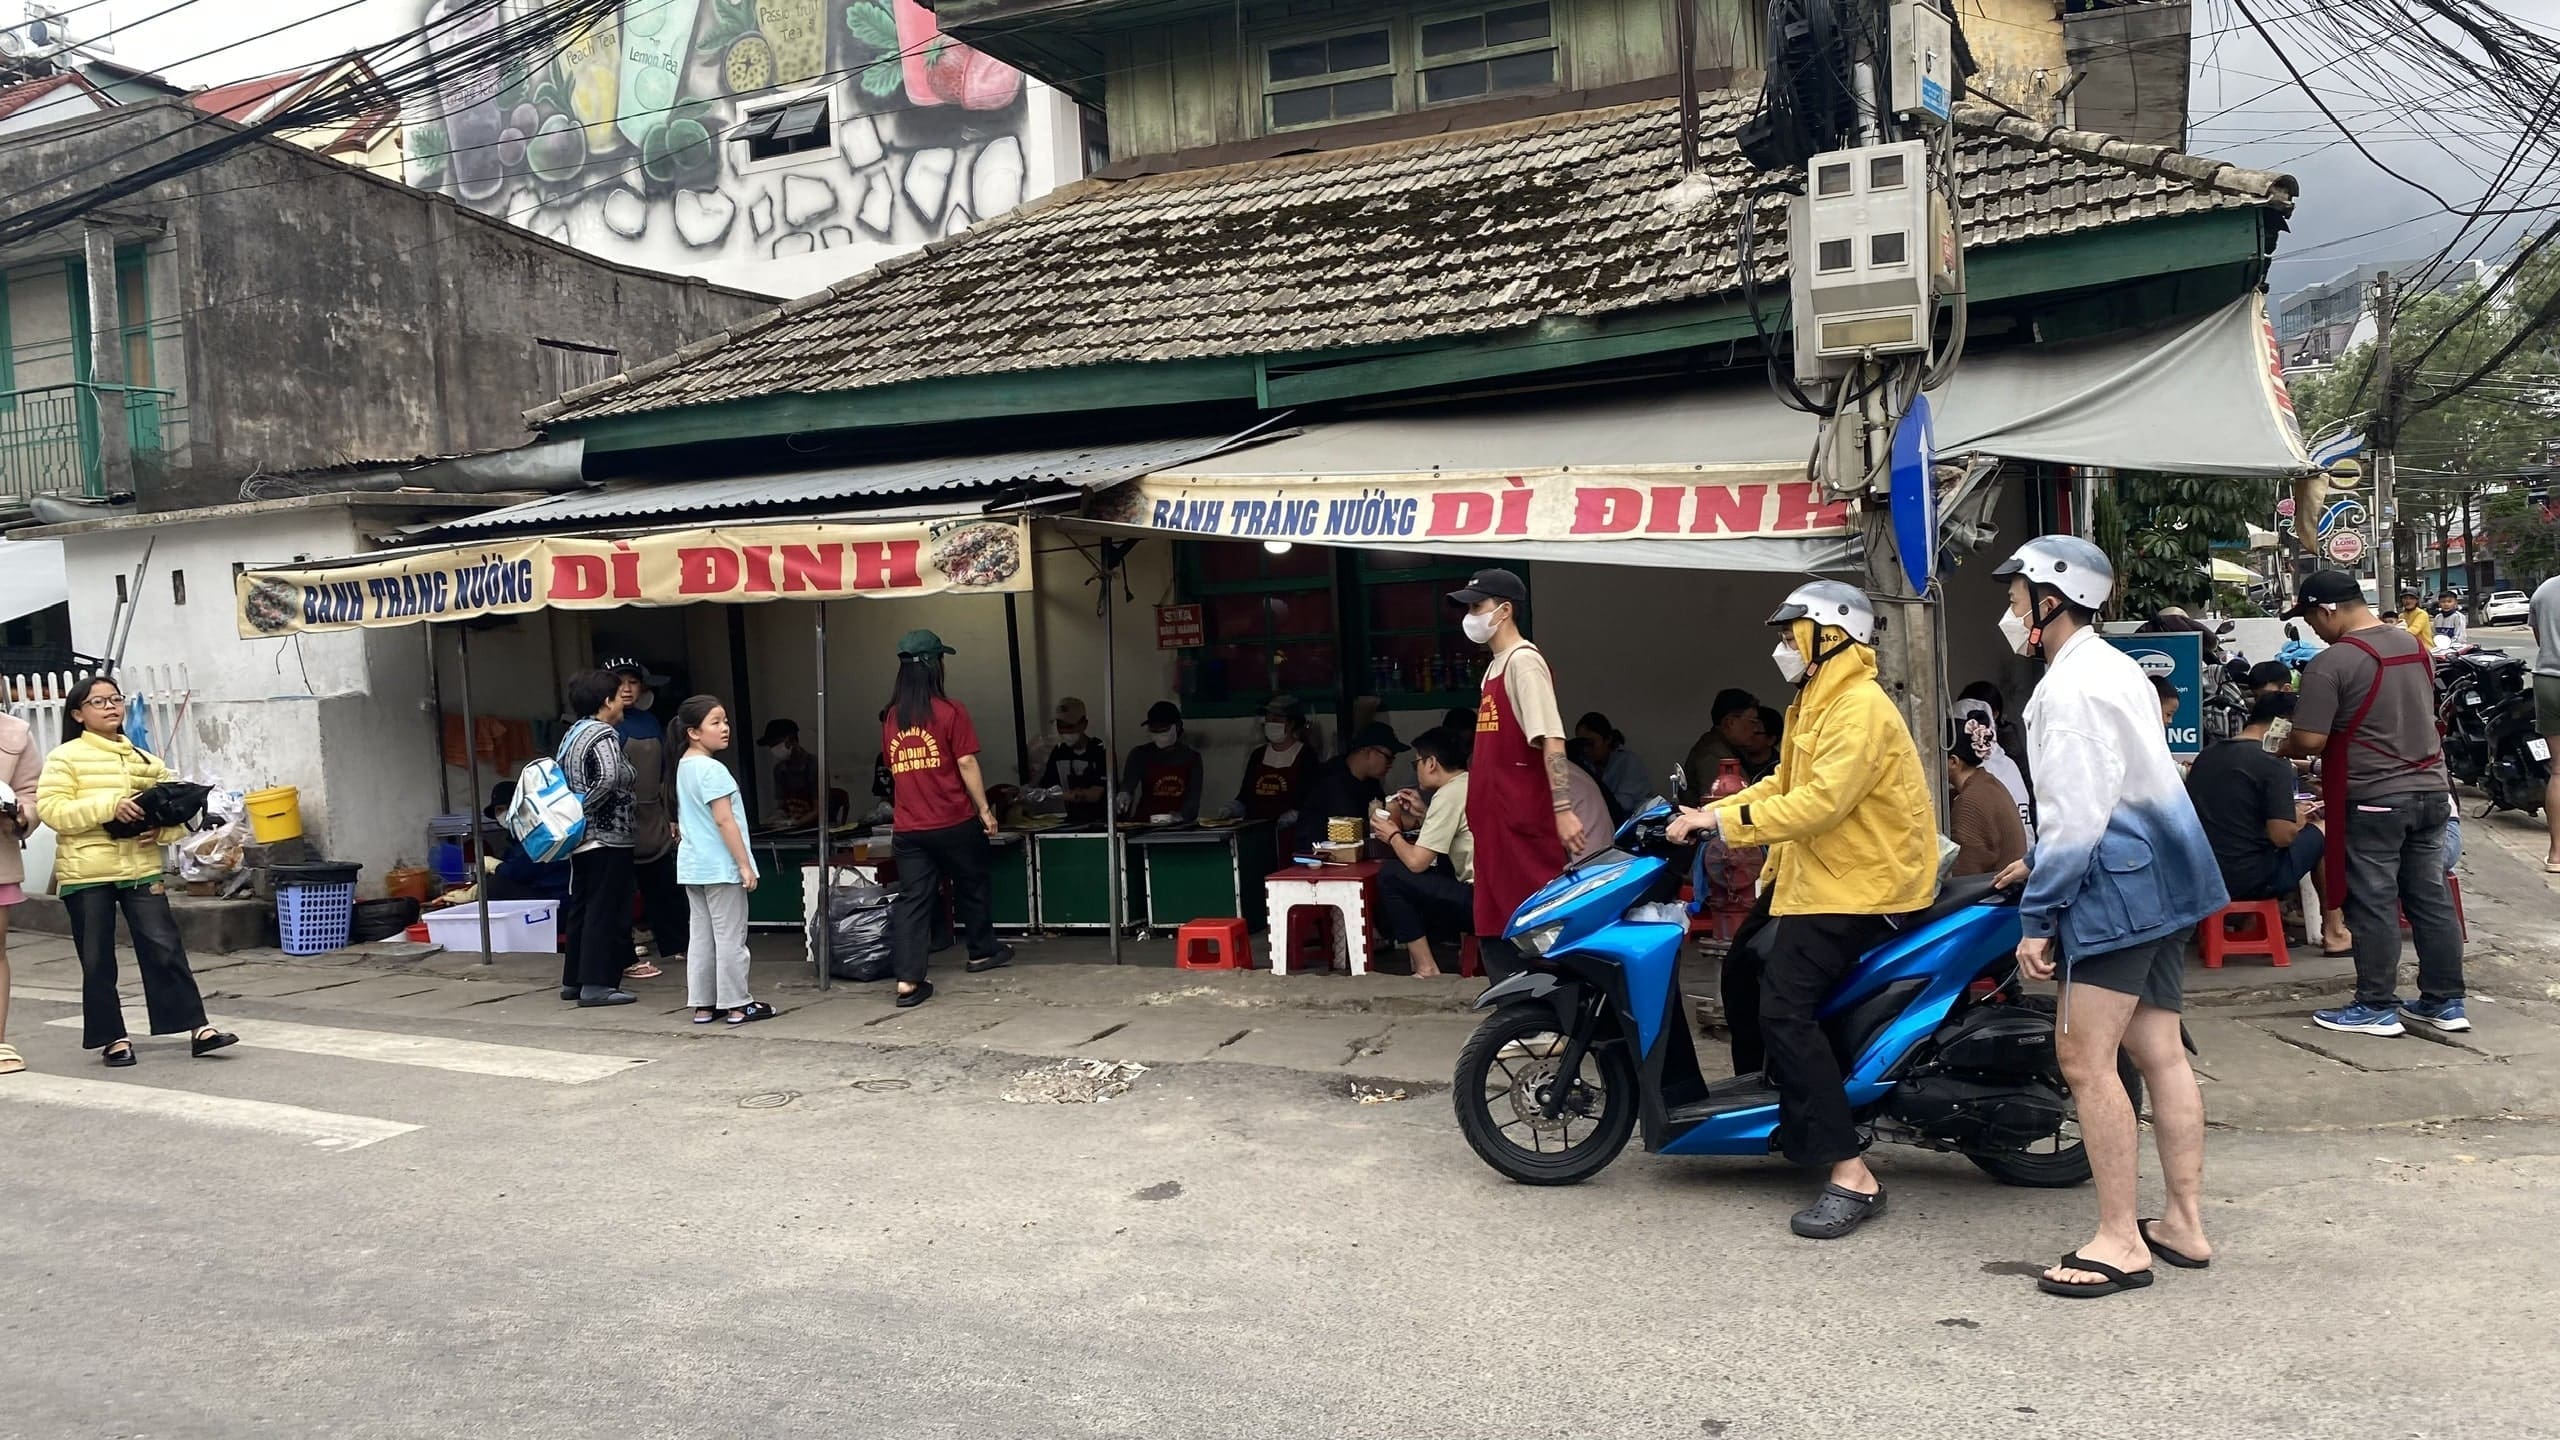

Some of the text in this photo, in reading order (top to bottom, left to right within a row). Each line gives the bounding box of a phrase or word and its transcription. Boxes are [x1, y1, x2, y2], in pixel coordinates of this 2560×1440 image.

[779, 27, 803, 42] Tea
[566, 33, 617, 68] Peach Tea
[629, 46, 678, 73] Lemon Tea
[1230, 489, 1320, 536] TRÁNG
[1323, 488, 1419, 536] NƯỚNG
[1425, 476, 1534, 536] DÌ
[1569, 482, 1849, 535] ĐINH
[303, 540, 925, 625] BÁNH TRÁNG NƯỚNG DÌ ĐINH
[2167, 727, 2197, 744] NG
